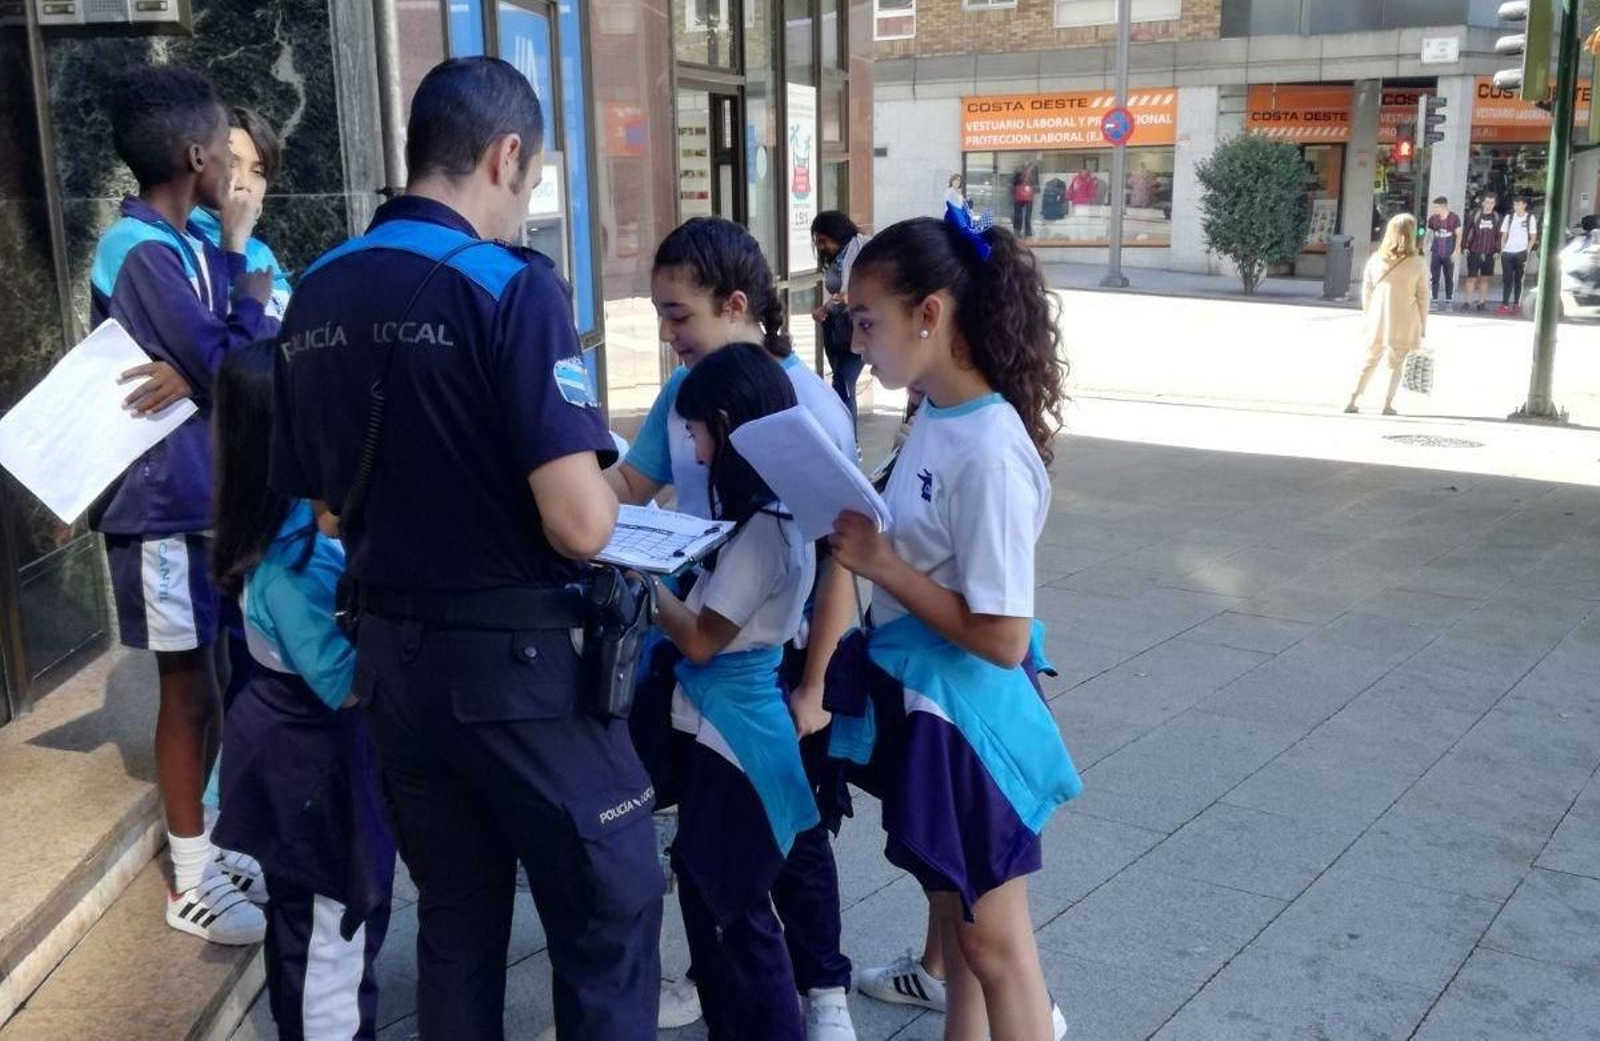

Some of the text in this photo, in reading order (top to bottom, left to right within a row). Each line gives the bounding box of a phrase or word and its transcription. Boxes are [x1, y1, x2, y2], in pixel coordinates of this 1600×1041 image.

[967, 98, 1088, 113] COSTA OESTE
[1382, 93, 1420, 106] COS
[965, 118, 1025, 132] VESTUARIO
[1026, 115, 1076, 129] LABORAL
[1079, 115, 1086, 126] Y
[1251, 111, 1349, 122] COSTA OESTE
[965, 134, 1031, 146] PROTECCION
[1033, 131, 1084, 144] LABORAL
[281, 321, 454, 363] POLICÍA LOCAL
